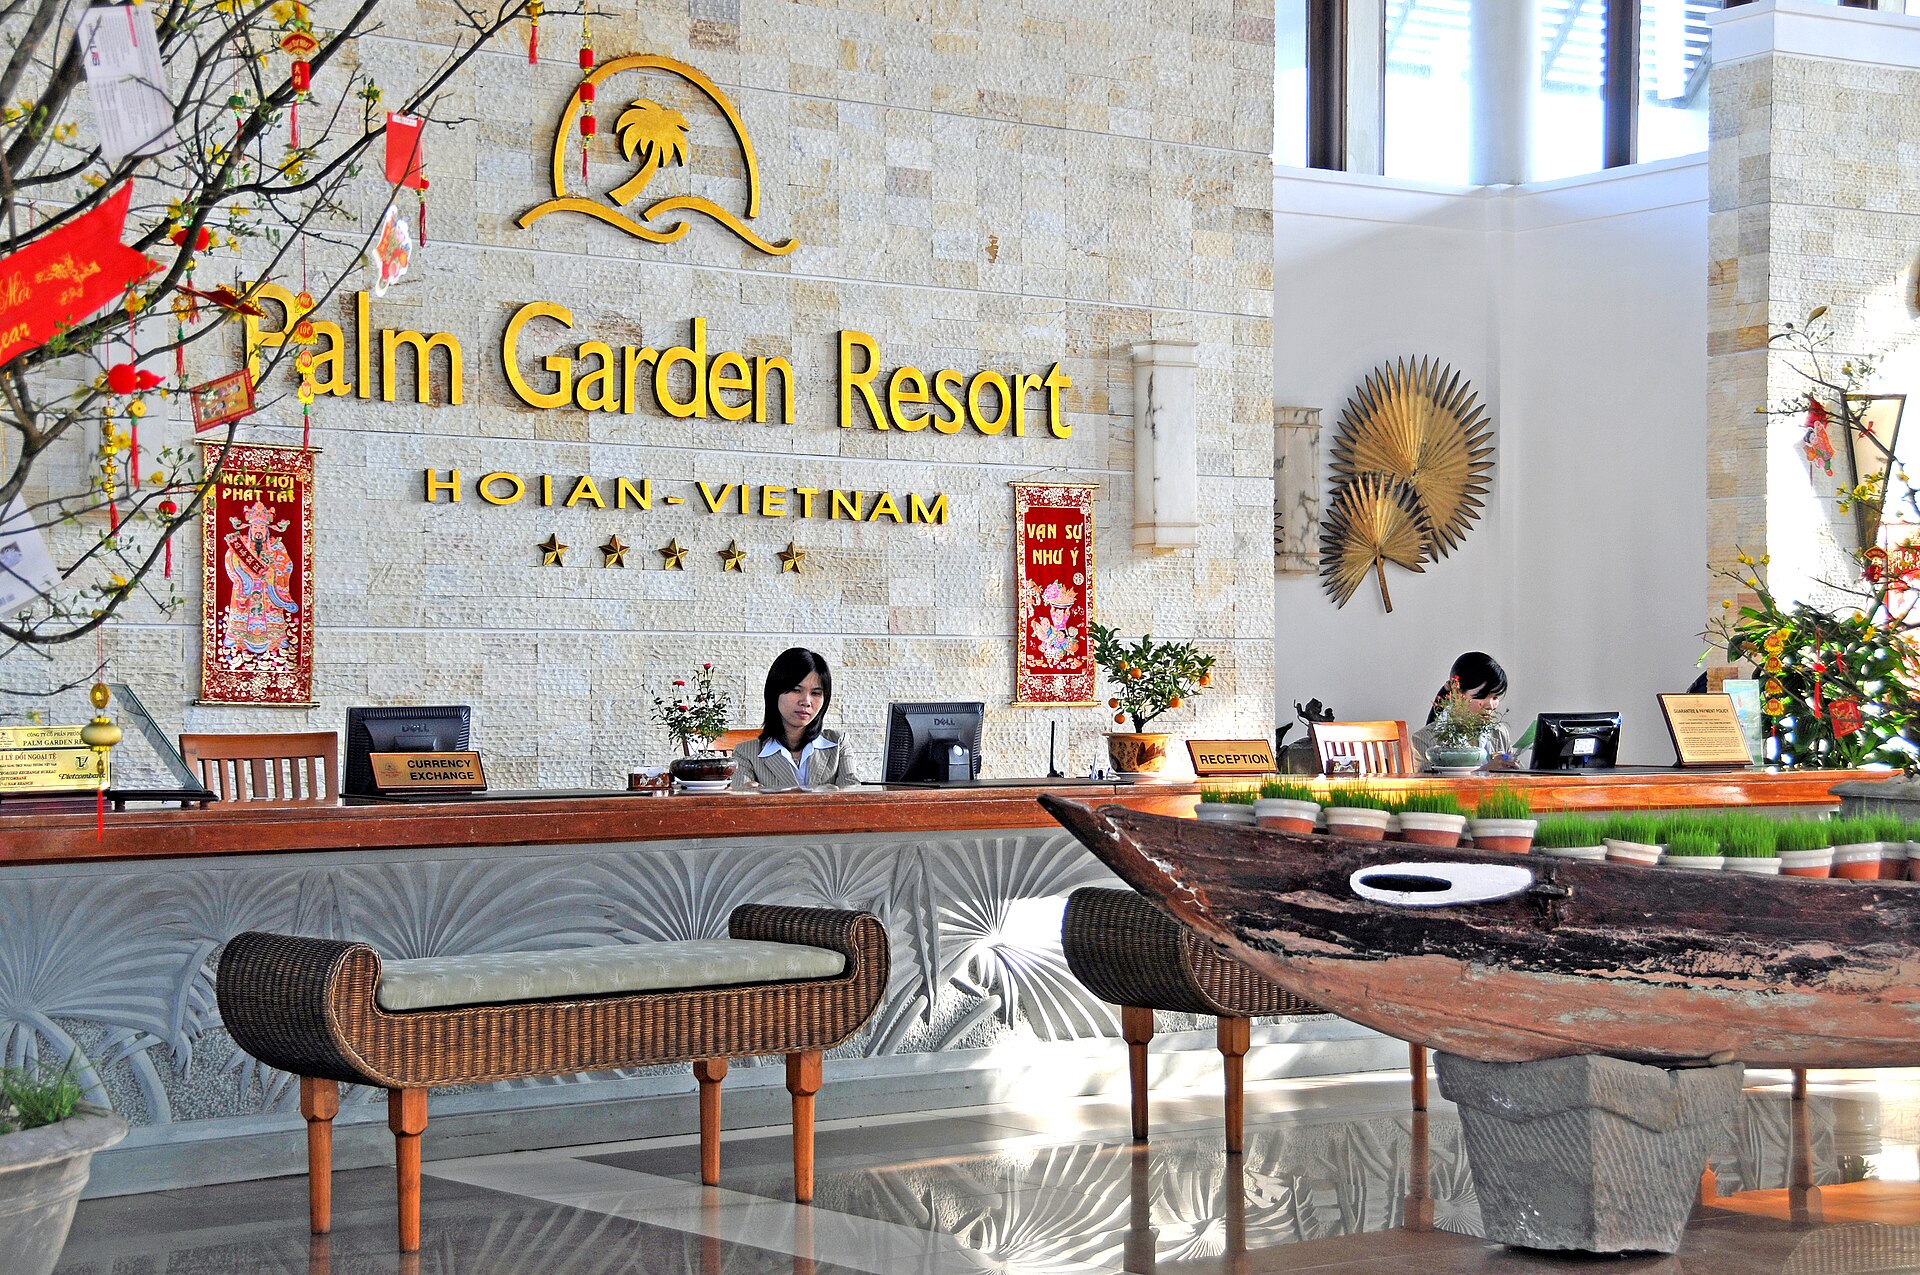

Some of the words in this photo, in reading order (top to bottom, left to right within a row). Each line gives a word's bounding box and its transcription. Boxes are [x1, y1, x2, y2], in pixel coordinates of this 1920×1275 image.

[0, 323, 30, 349] ear
[244, 280, 463, 405] Palm
[502, 302, 795, 423] Garden
[839, 330, 1072, 438] Resort
[267, 487, 297, 503] TÀ
[1026, 523, 1057, 543] VẠN
[1065, 522, 1084, 543] SỰ
[1032, 547, 1065, 567] NHƯ
[1070, 546, 1079, 567] Ý
[407, 759, 471, 769] CURRENCY
[1200, 754, 1270, 765] RECEPTION
[410, 771, 475, 781] EXCHANGE
